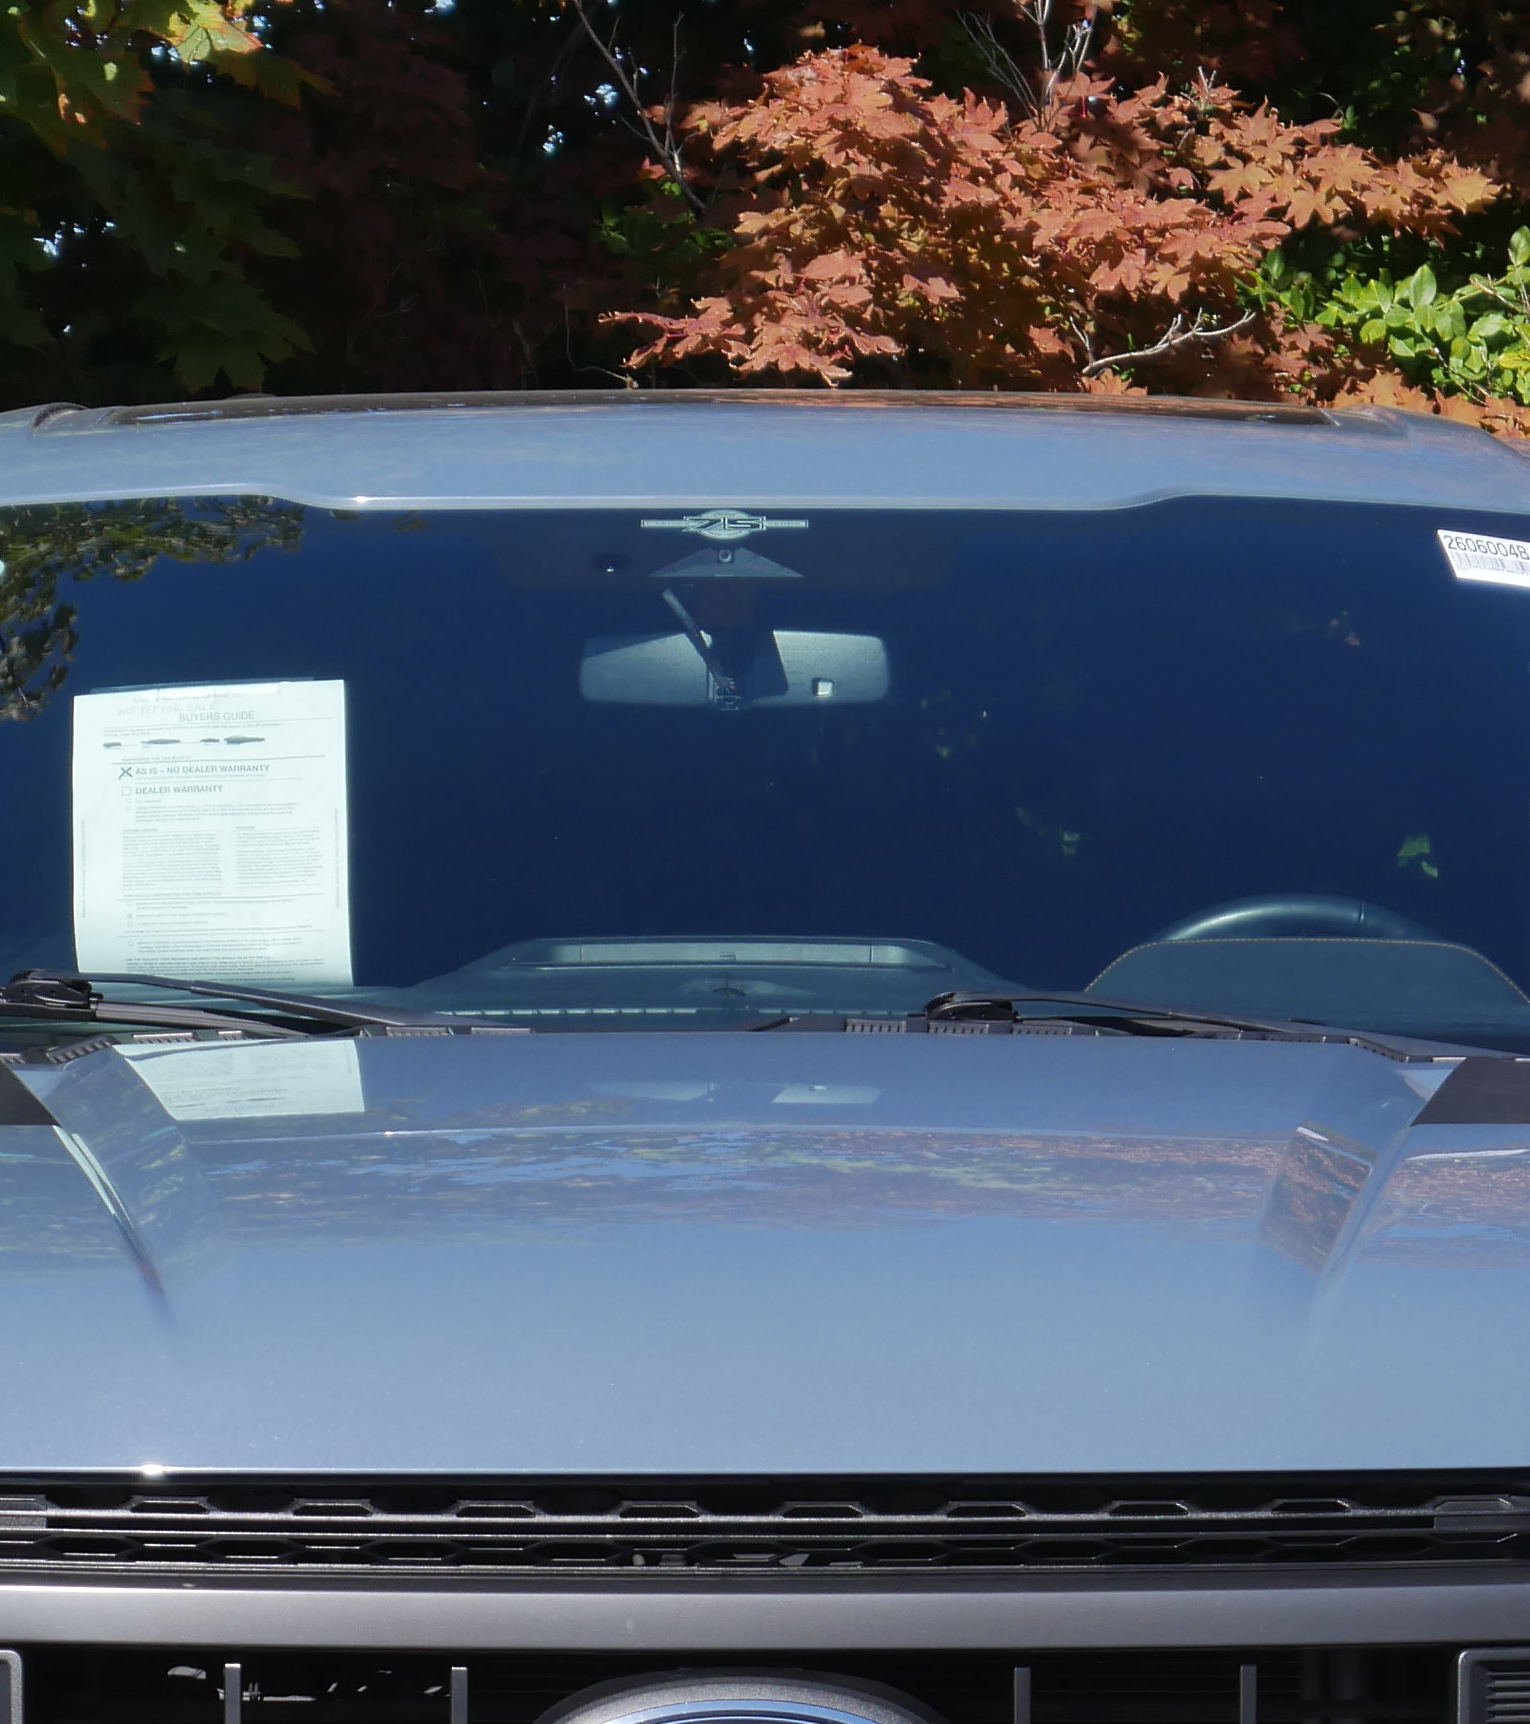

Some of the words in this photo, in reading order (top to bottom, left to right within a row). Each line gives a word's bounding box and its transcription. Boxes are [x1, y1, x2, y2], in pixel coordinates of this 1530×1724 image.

[178, 711, 220, 722] BUYERS
[223, 710, 255, 720] GUIDE
[182, 765, 218, 774] DEALER
[219, 764, 270, 773] WARRANTY
[135, 786, 171, 795] DEALER
[173, 785, 223, 794] WARRANTY
